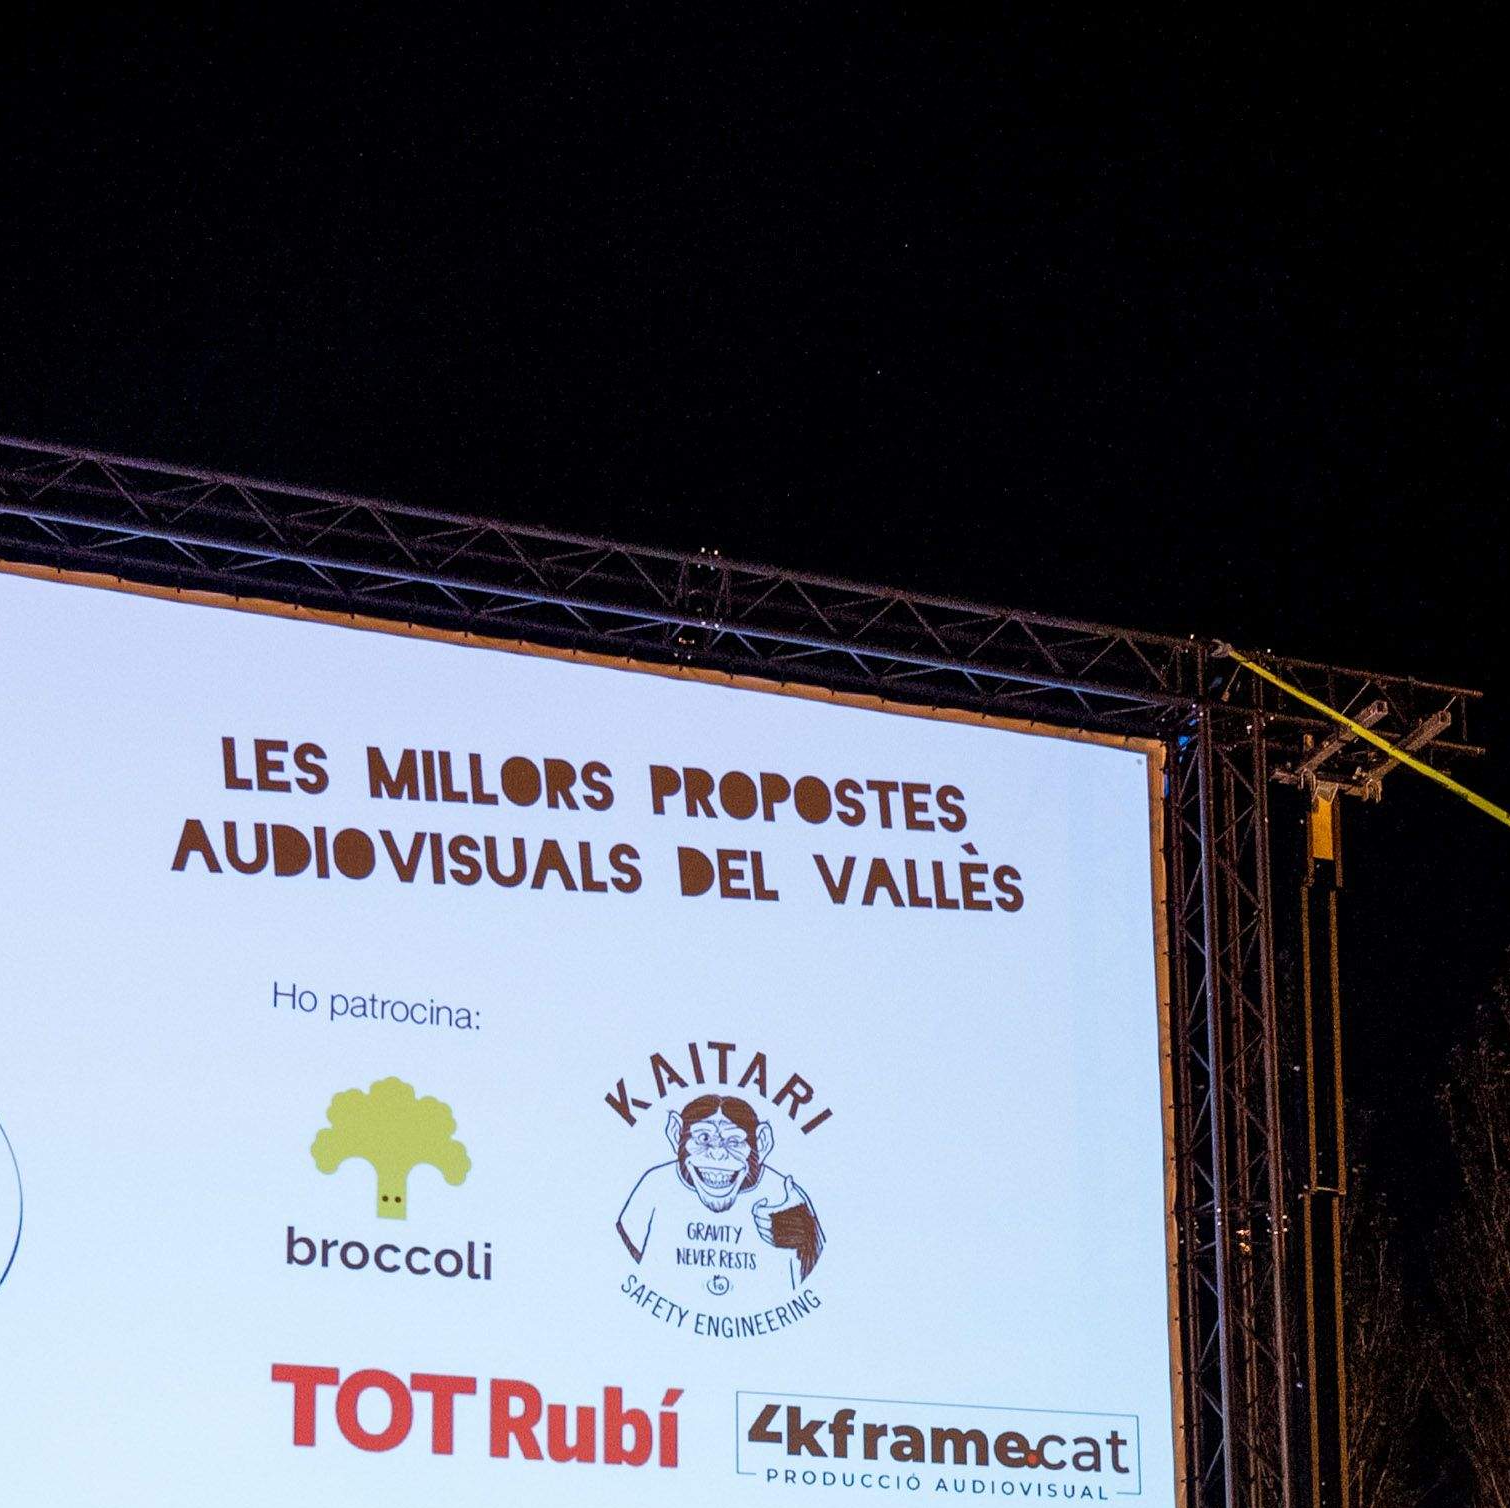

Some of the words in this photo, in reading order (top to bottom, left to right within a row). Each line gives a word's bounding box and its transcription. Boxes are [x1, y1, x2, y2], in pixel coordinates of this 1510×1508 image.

[221, 736, 330, 795] LES
[366, 745, 615, 812] MILLORS
[649, 764, 968, 834] PROPOSTES
[170, 818, 643, 894] AUDIOVISUALS
[676, 846, 780, 902] DEL
[812, 841, 1025, 913] VALLÈS
[272, 980, 319, 1013] Ho
[329, 993, 481, 1031] patrocina:
[604, 1040, 833, 1136] KAITARI
[286, 1225, 492, 1281] broccoli
[675, 1247, 717, 1268] NEVER
[718, 1248, 757, 1271] RESTS
[686, 1221, 743, 1245] GRAVITY
[620, 1273, 690, 1330] SAFETY
[693, 1288, 823, 1339] ENGINEERING
[766, 1467, 921, 1492] PRODUCCIÓ
[934, 1477, 1109, 1501] AUDIOVISUAL
